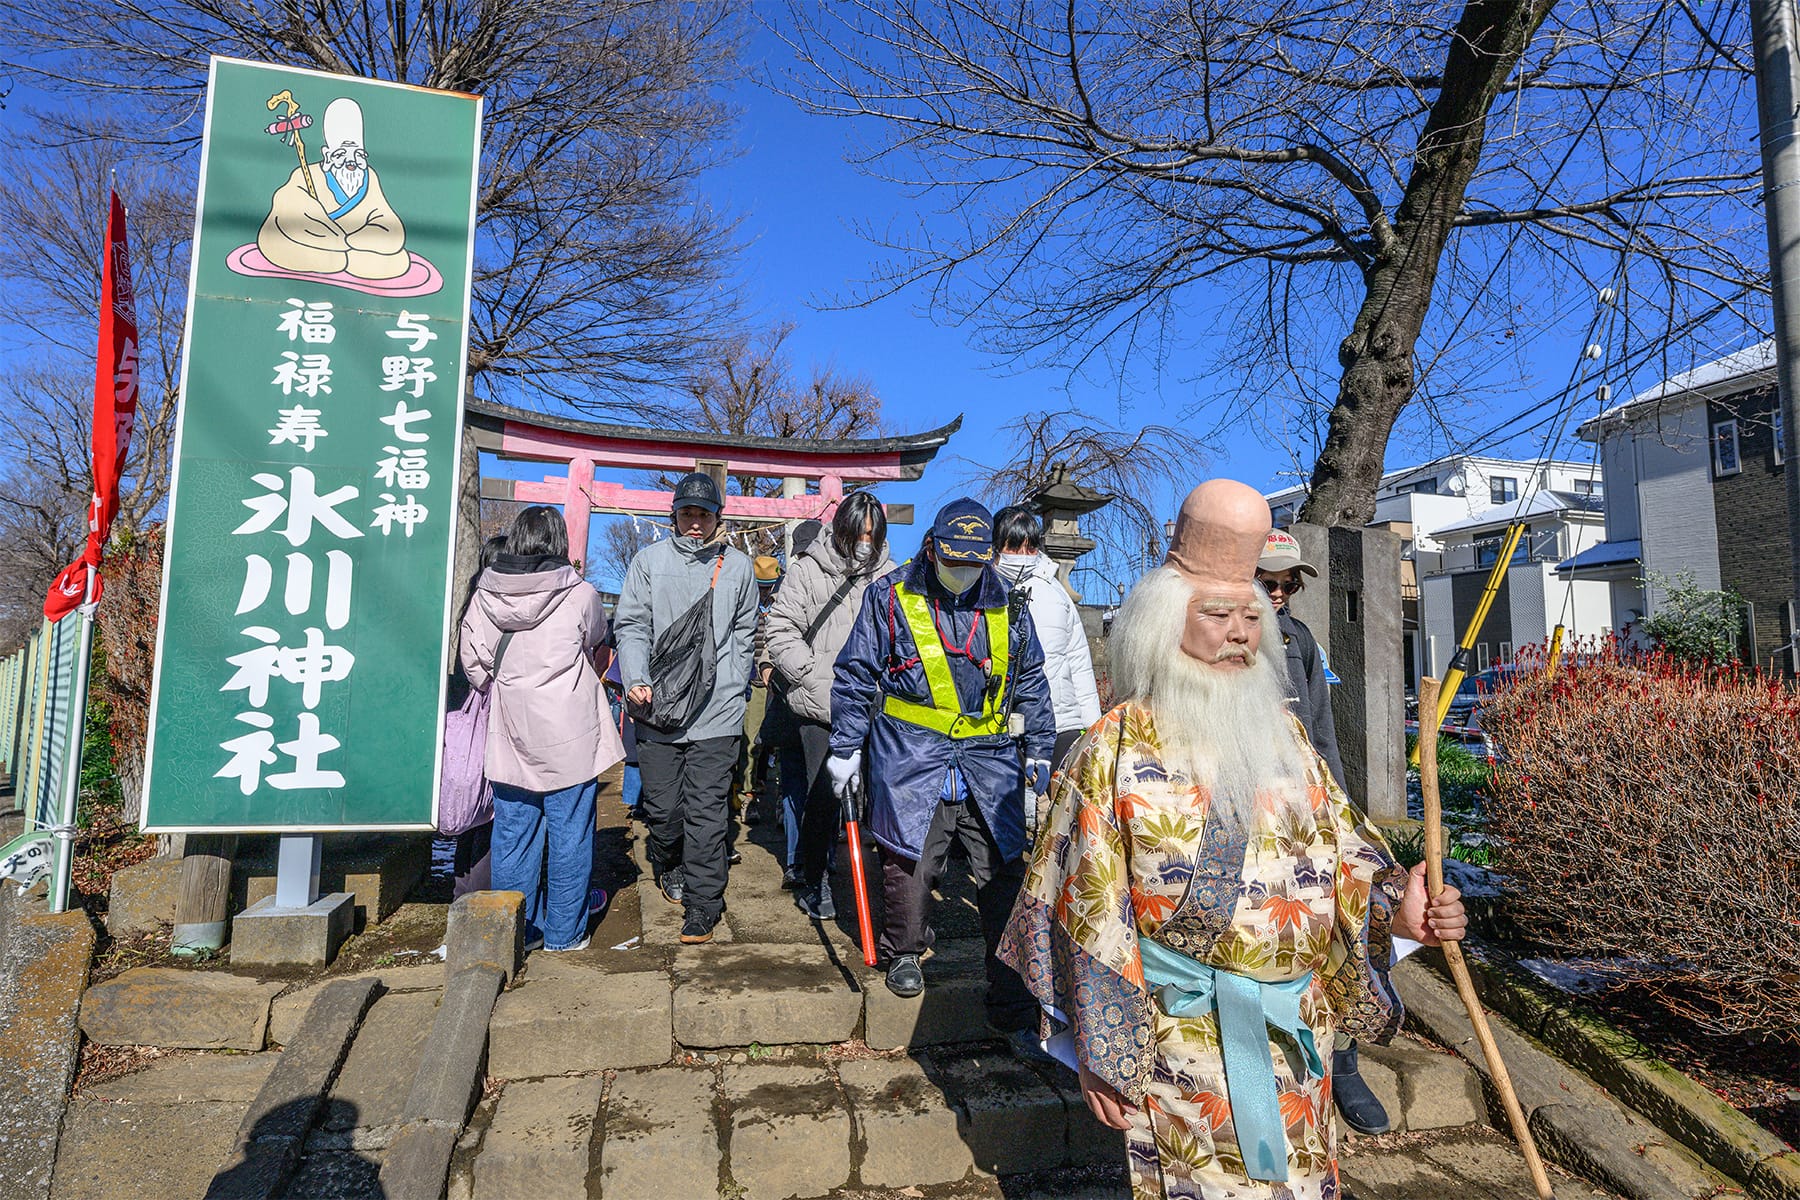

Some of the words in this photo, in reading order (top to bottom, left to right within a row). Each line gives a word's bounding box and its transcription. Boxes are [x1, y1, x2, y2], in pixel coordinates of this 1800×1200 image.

[267, 297, 337, 454] 福禄寿
[369, 309, 439, 539] 与野七福神
[212, 465, 366, 796] 氷川神社
